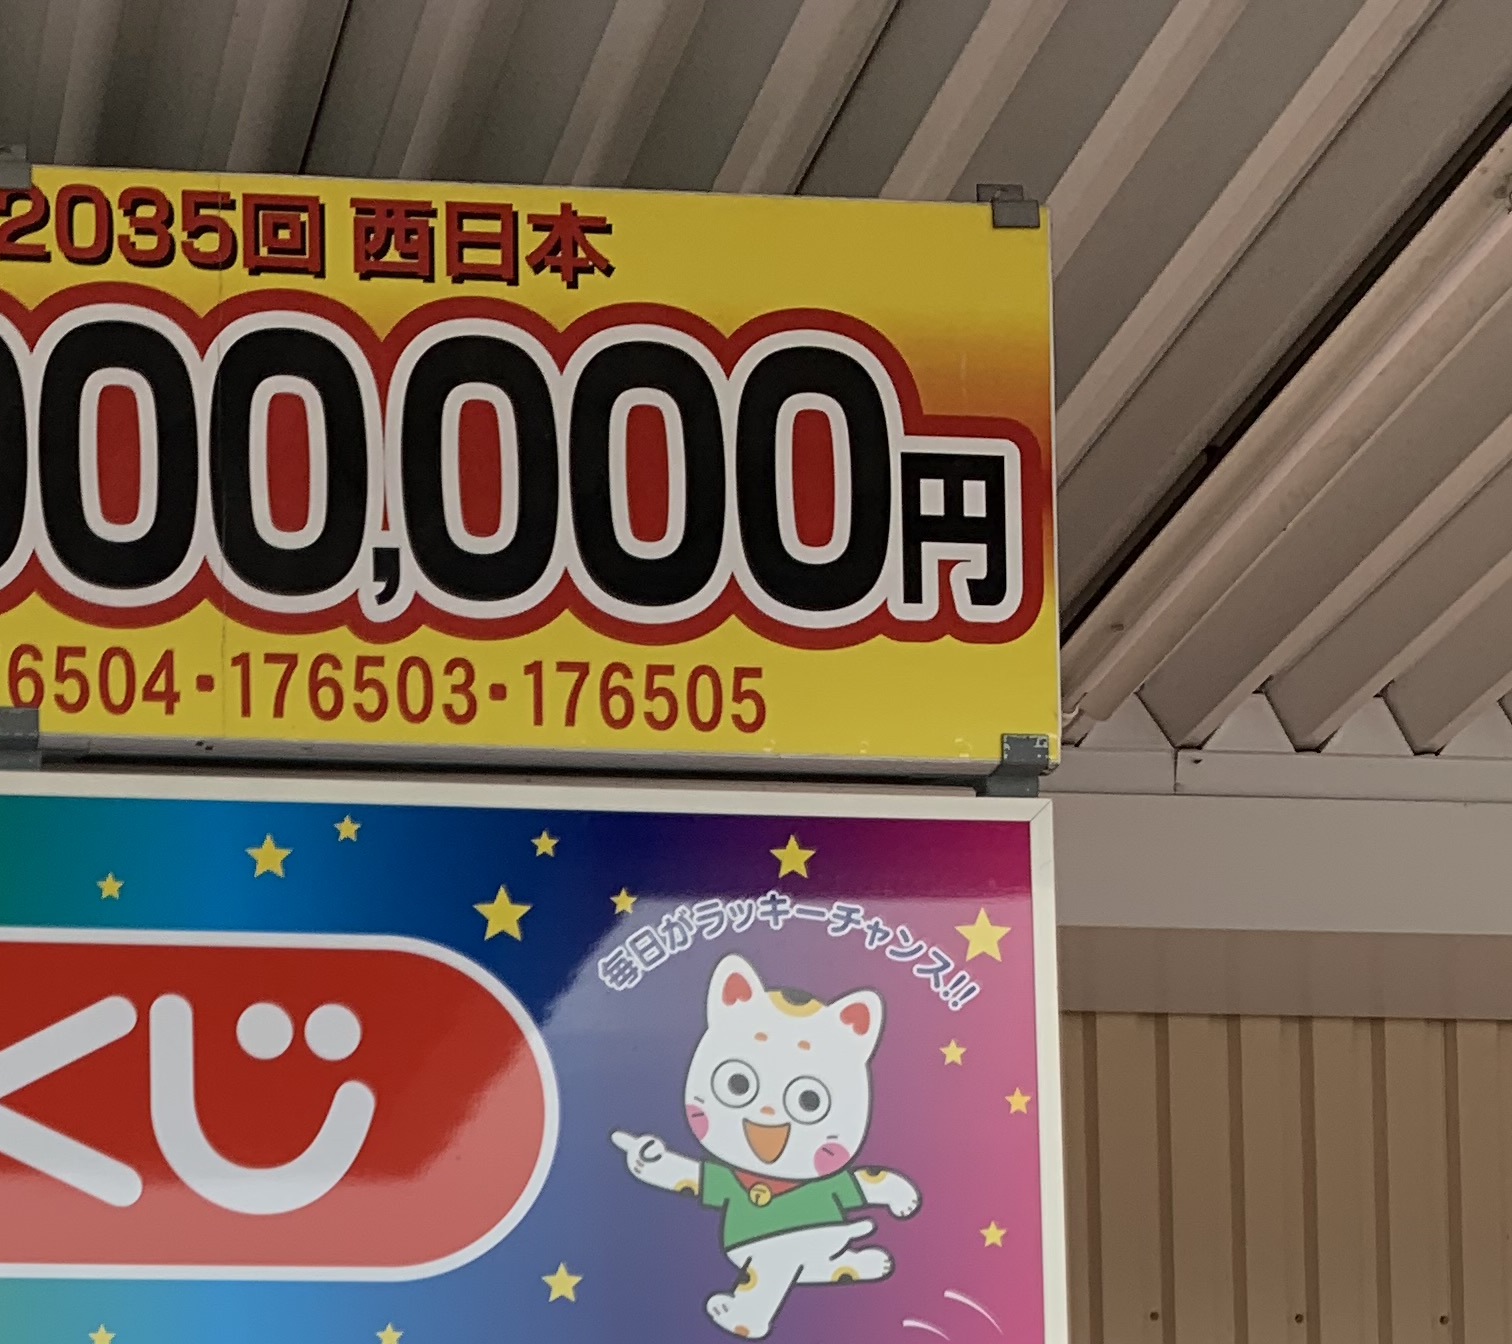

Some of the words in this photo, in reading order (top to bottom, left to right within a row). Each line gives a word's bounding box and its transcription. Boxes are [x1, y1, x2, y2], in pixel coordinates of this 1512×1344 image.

[352, 196, 614, 287] 西日本
[598, 891, 980, 1011] 毎日がラッキーチャンス!!
